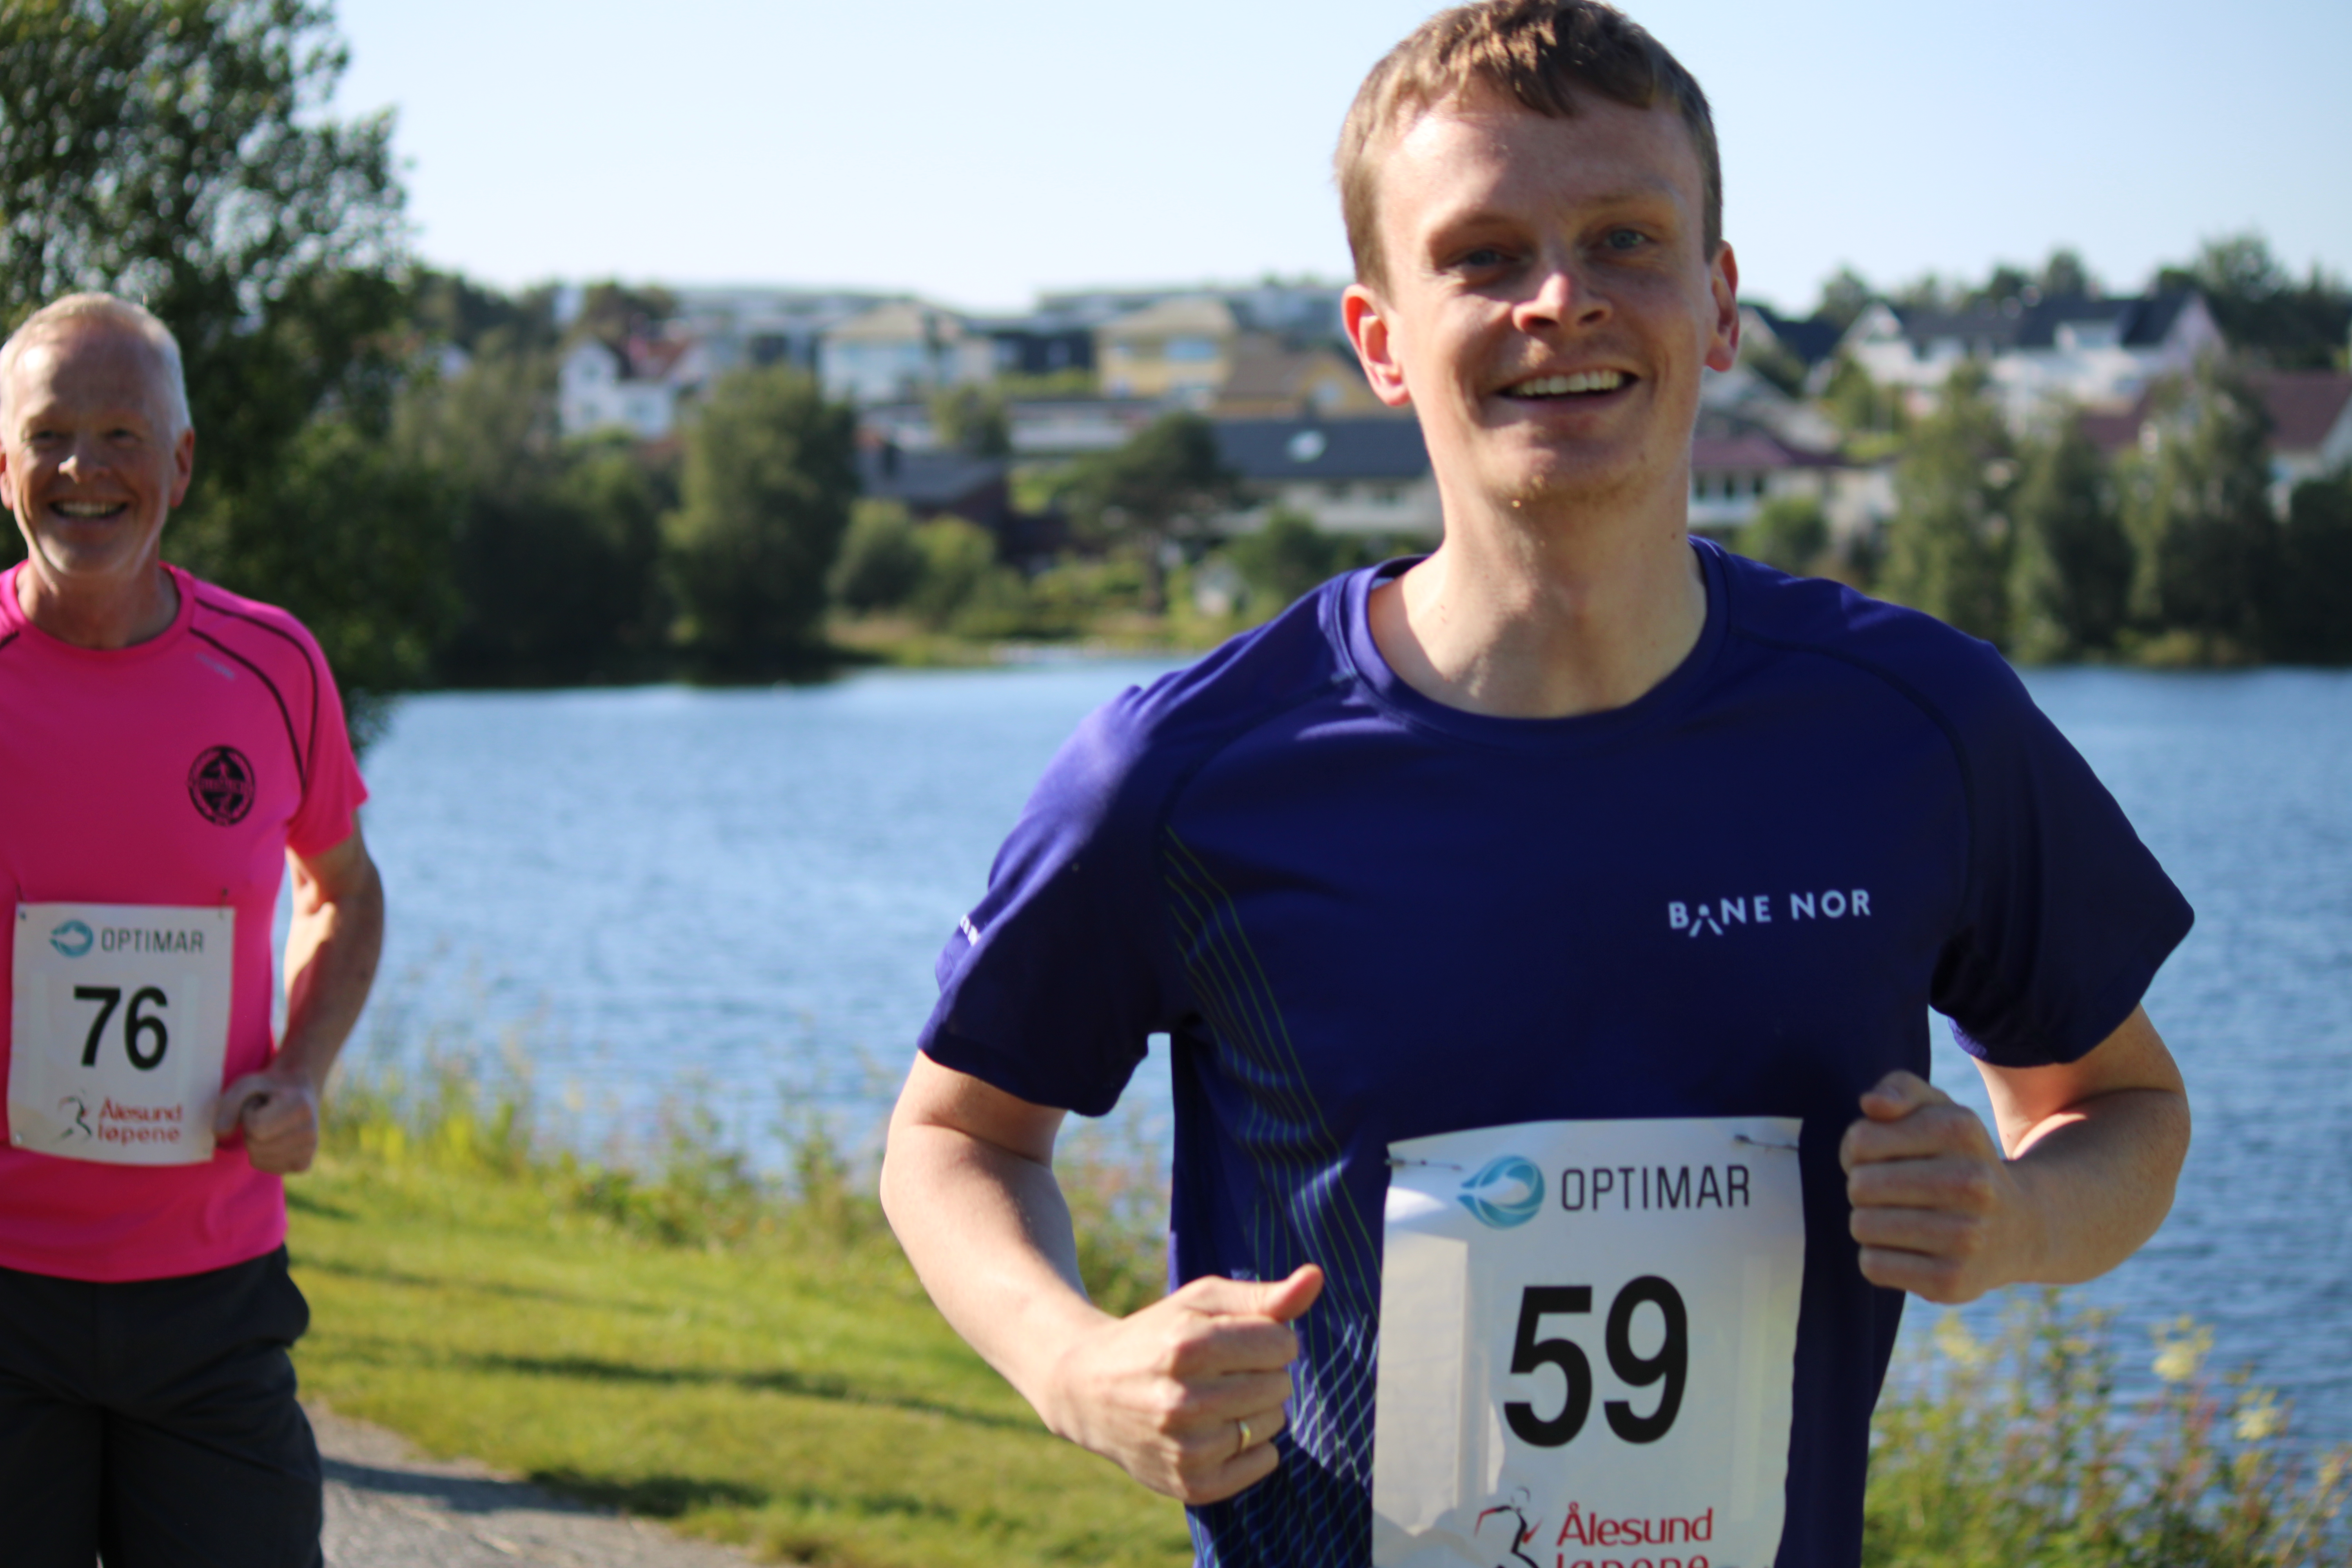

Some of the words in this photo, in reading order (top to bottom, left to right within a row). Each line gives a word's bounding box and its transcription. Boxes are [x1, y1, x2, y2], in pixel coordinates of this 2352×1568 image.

[1668, 895, 1771, 938] BANE
[1790, 889, 1871, 921] NOR
[101, 927, 204, 953] OPTIMAR
[73, 985, 169, 1072] 76
[1561, 1165, 1750, 1211] OPTIMAR
[1503, 1274, 1688, 1448] 59
[1556, 1501, 1713, 1546] Ålesund
